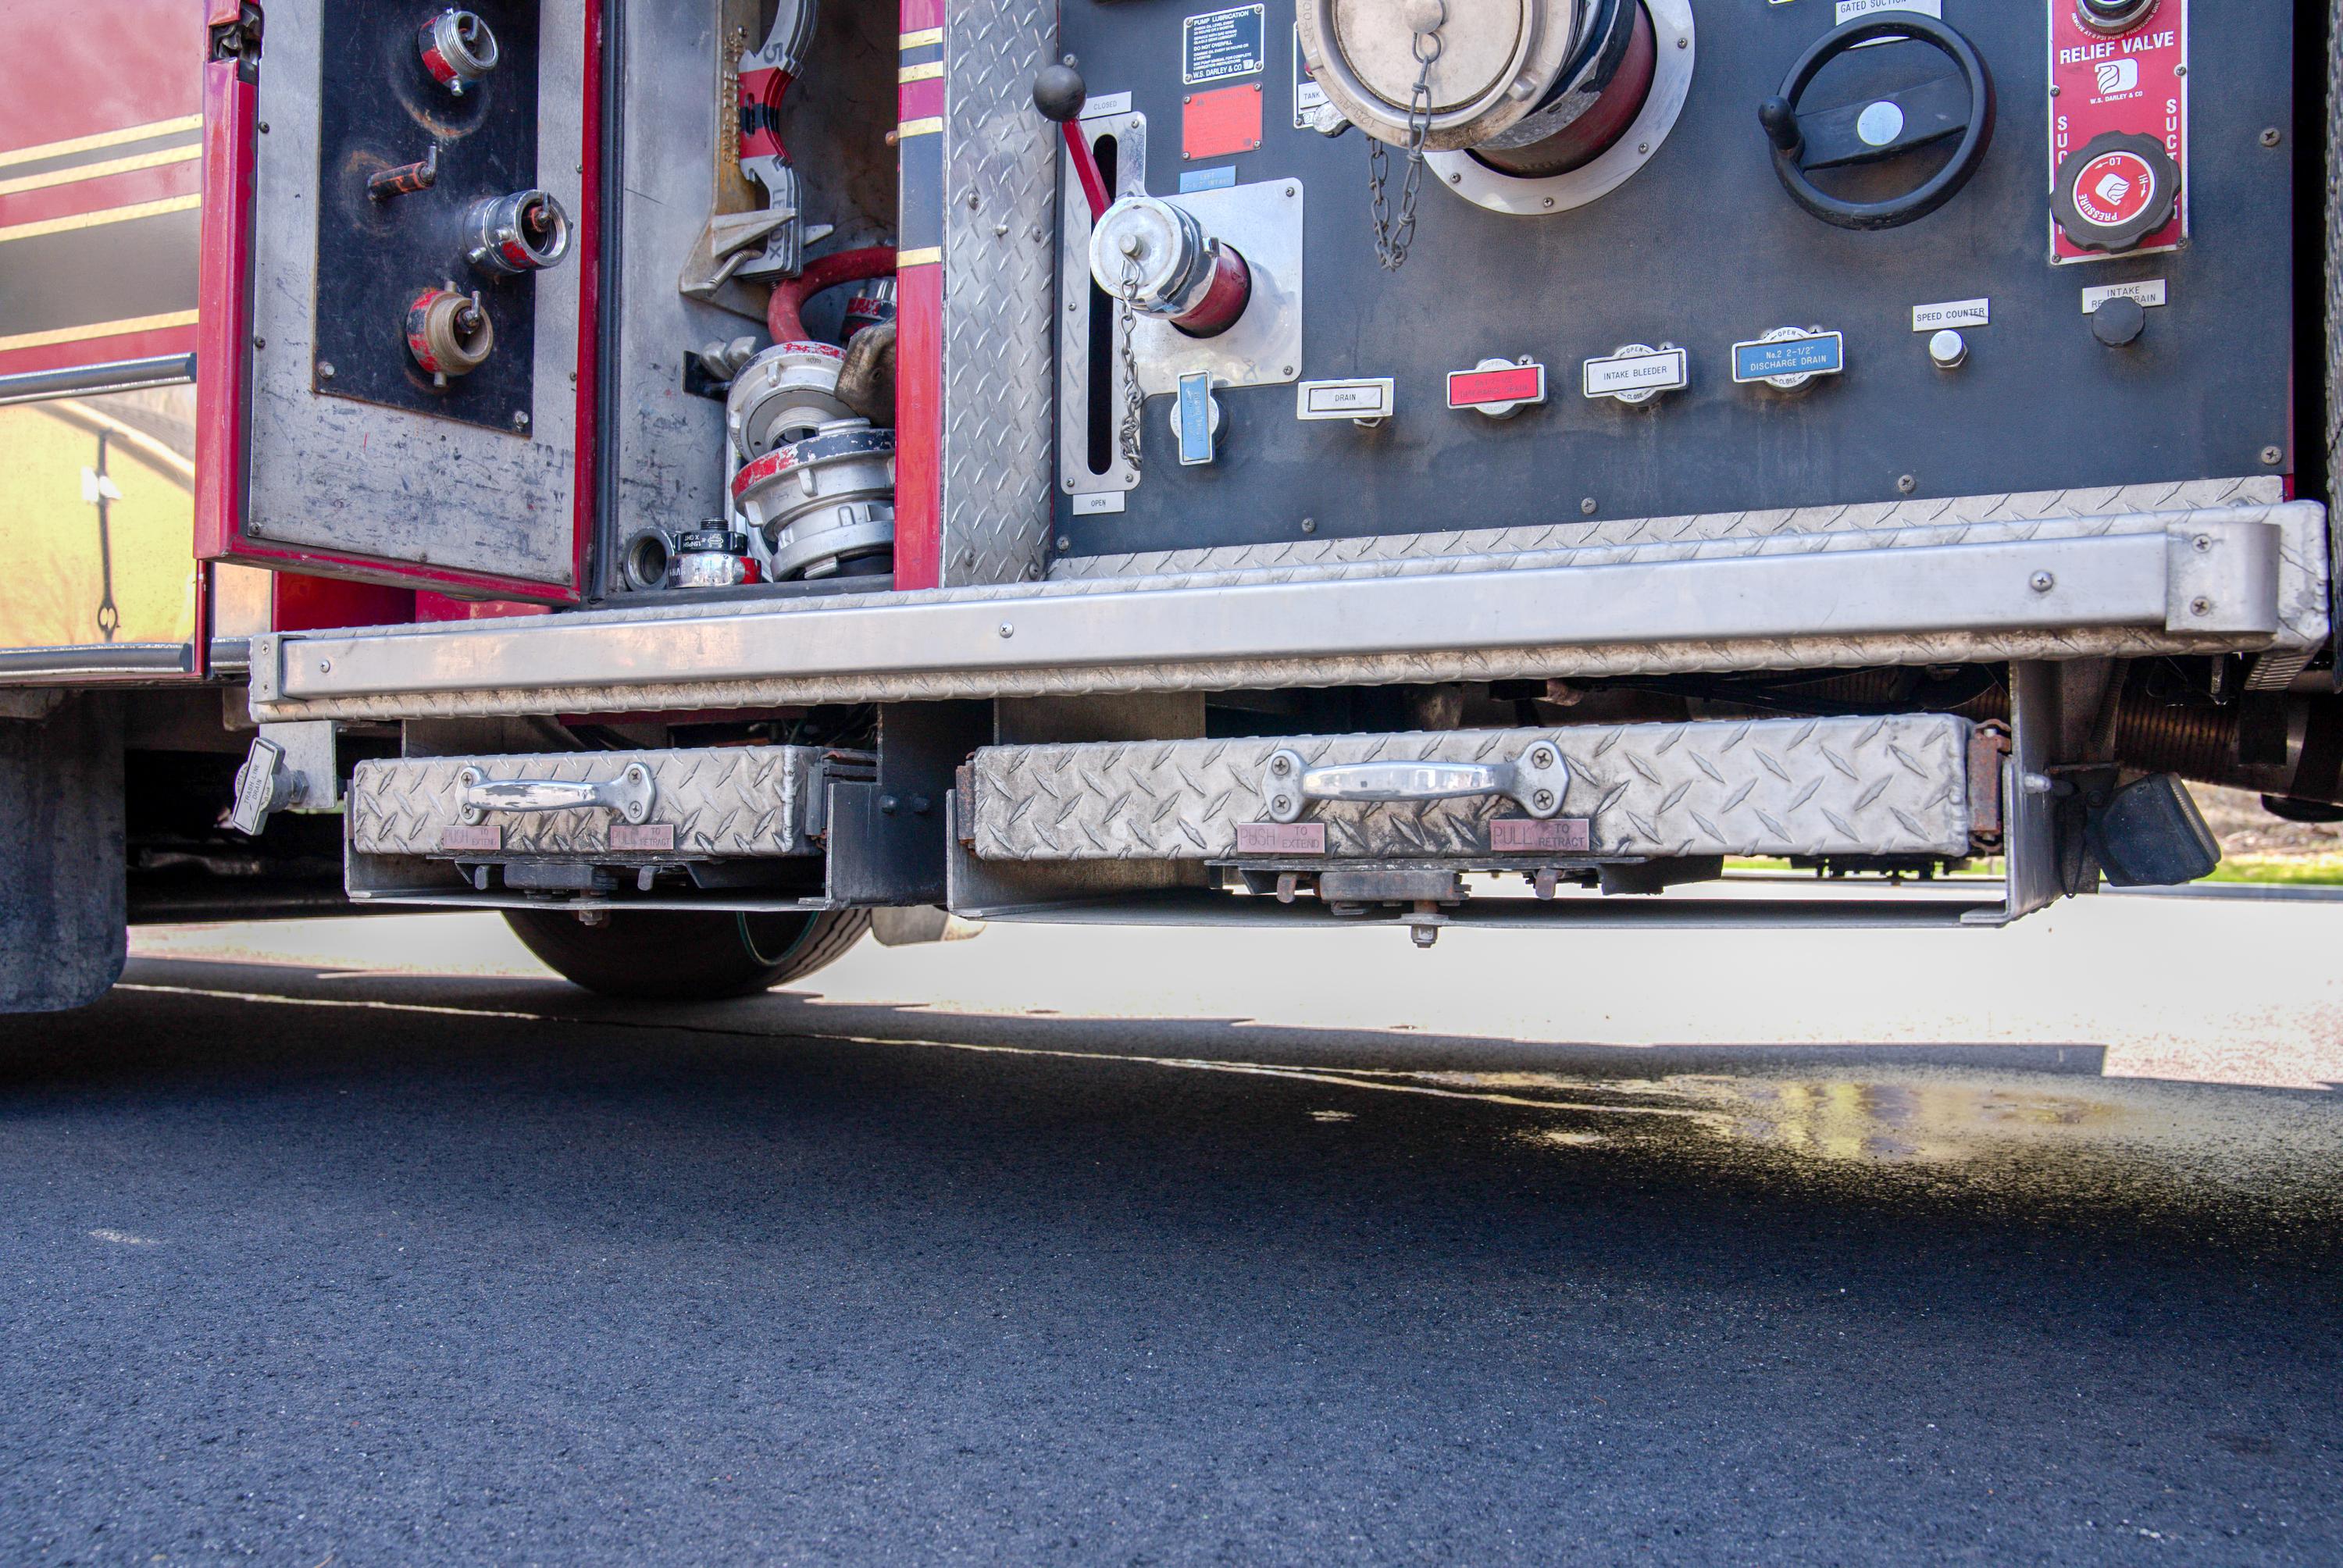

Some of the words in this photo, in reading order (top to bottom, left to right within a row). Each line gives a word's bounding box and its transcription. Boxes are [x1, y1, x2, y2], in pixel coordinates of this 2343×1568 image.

[1841, 4, 1866, 13] GATED
[1212, 10, 1249, 22] LUBRICATION
[2071, 12, 2084, 32] REMOVE
[2126, 14, 2154, 36] PRESSURE
[2152, 0, 2162, 13] ONL
[763, 42, 784, 64] 5
[2059, 41, 2115, 65] RELIEF
[2121, 30, 2174, 54] VALVE
[1206, 66, 1227, 77] DARLEY
[1234, 63, 1242, 72] CO
[1303, 91, 1320, 101] TANK
[2105, 93, 2127, 102] DARLEY
[1093, 100, 1117, 110] CLOSED
[2109, 157, 2122, 166] LO
[2138, 173, 2149, 184] HI
[2077, 193, 2118, 221] PRESSURE
[769, 188, 785, 260] LEOX
[2106, 286, 2141, 298] INTAKE
[2134, 294, 2156, 304] RAIN
[1917, 312, 1942, 323] SPEED
[1945, 307, 1985, 319] COUNTER
[1766, 350, 1781, 359] No.2
[1750, 360, 1797, 372] DISCHARGE
[1801, 355, 1827, 365] DRAIN
[1603, 370, 1630, 380] INTAKE
[1633, 365, 1667, 377] BLEEDER
[1778, 376, 1797, 385] CLOSE
[1335, 394, 1357, 402] DRAIN
[244, 782, 255, 804] TRASH
[251, 764, 260, 779] LINE
[251, 779, 262, 800] DRAIN
[651, 827, 662, 836] TO
[1293, 826, 1308, 836] TO
[1554, 823, 1570, 834] TO
[445, 829, 469, 844] PUSH
[612, 830, 637, 845] PULL
[1240, 828, 1276, 846] PUSH
[1492, 825, 1532, 845] PULL
[472, 837, 497, 846] EXTEND
[640, 838, 671, 846] RETRACT
[1282, 838, 1320, 849] EXTEND
[1538, 836, 1585, 847] RETRACT
